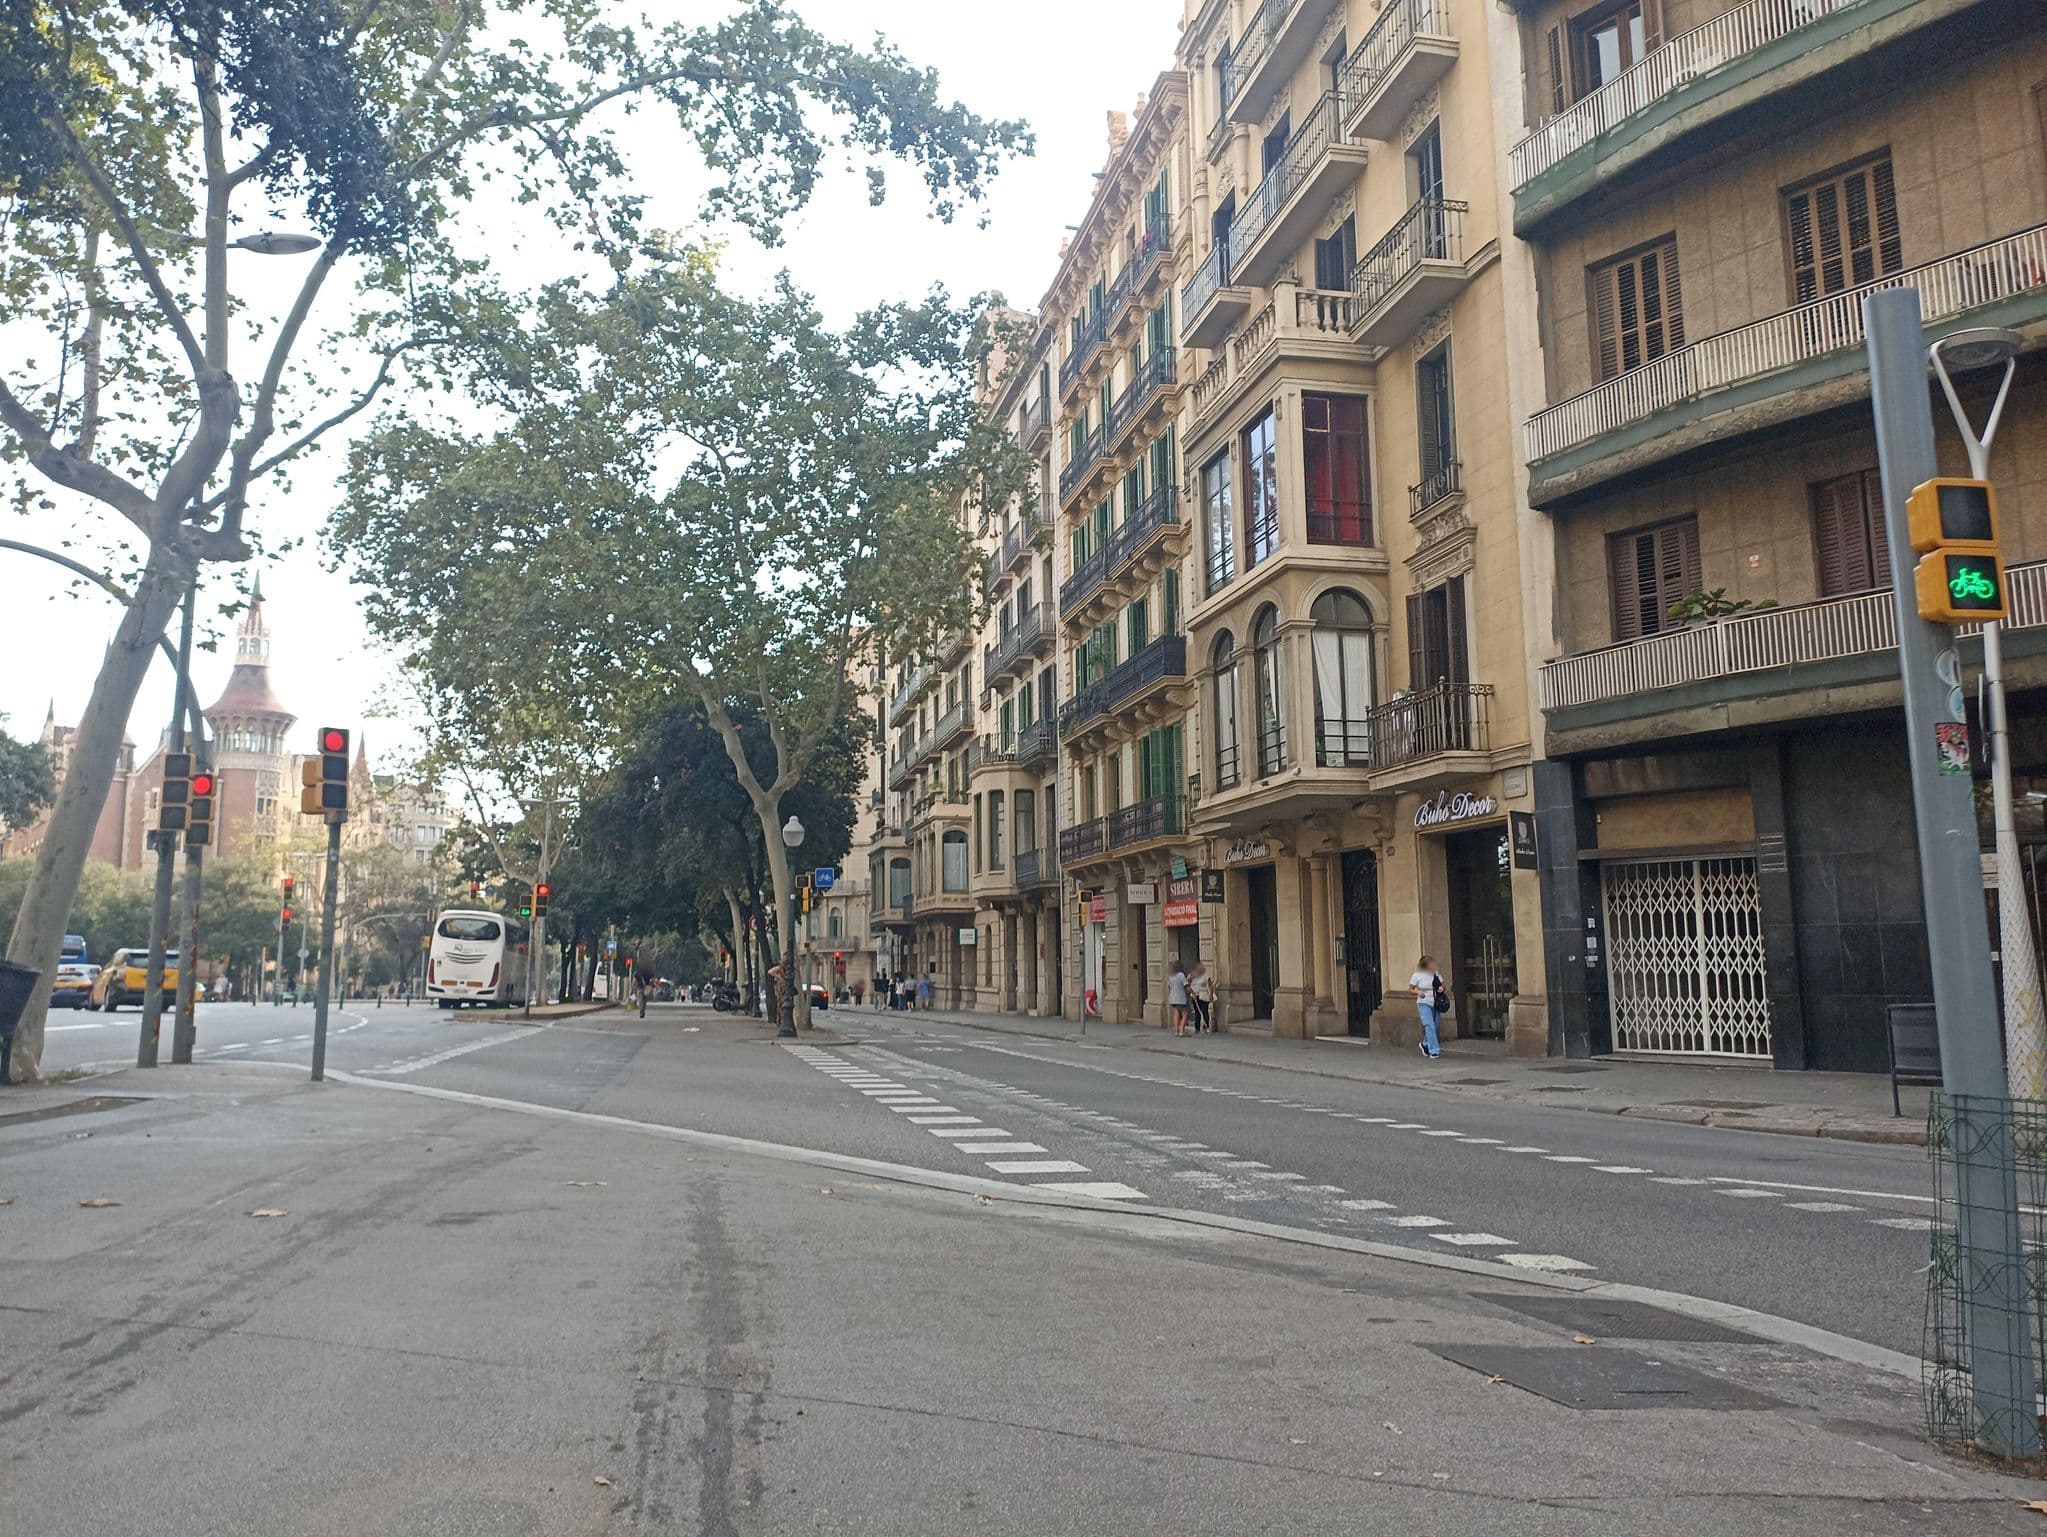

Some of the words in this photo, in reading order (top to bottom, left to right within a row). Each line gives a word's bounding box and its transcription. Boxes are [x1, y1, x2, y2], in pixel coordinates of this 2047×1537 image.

[1414, 790, 1449, 826] Buho
[1450, 792, 1497, 819] Decor
[1243, 841, 1267, 859] Decor
[1170, 880, 1194, 897] SIRERA
